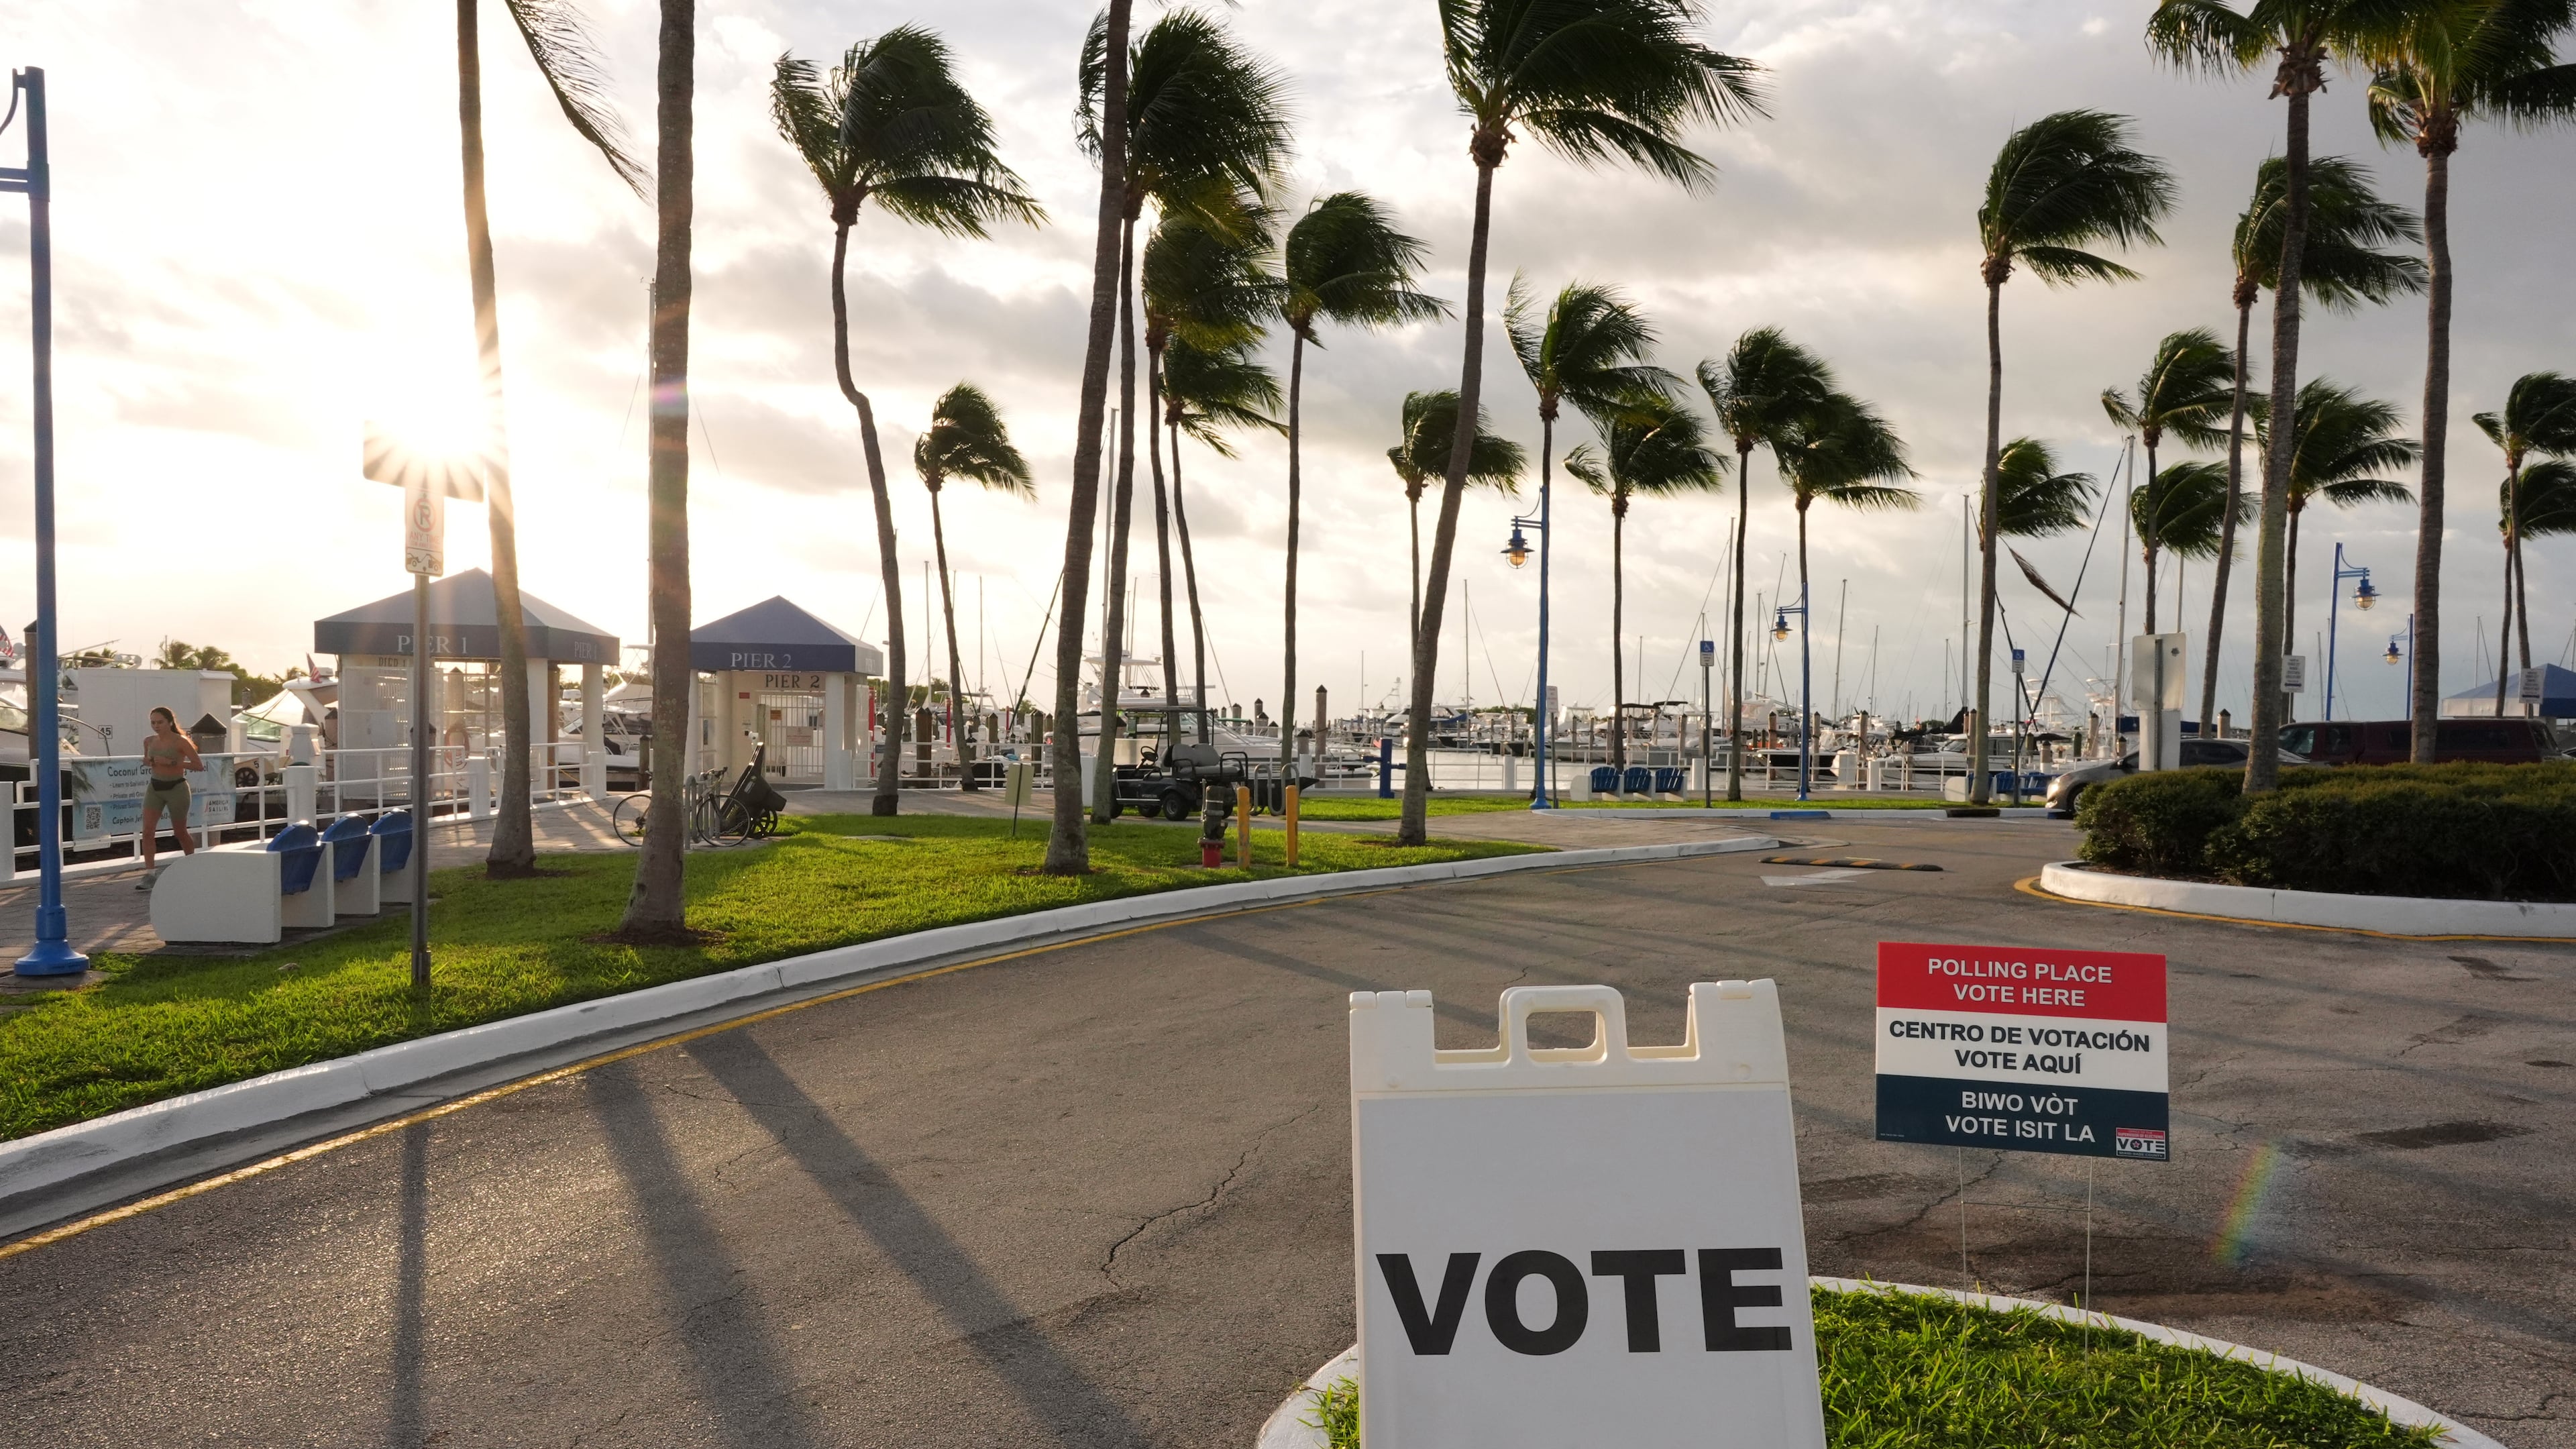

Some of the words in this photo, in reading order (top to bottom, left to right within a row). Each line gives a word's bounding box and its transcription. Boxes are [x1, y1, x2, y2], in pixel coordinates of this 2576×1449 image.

[397, 635, 452, 654] PER
[462, 637, 468, 654] 1
[574, 641, 592, 660] PIER
[731, 653, 776, 668] PIER
[782, 654, 792, 668] 2
[765, 674, 800, 688] PIER
[810, 675, 820, 688] 2
[107, 766, 138, 777] Coconut
[113, 816, 134, 826] Captain
[1928, 958, 2027, 979] POLLING
[2035, 963, 2112, 983] PLACE
[1953, 983, 2015, 1004] VOTE
[2022, 987, 2085, 1007] HERE
[1889, 1020, 1984, 1042] CENTRO
[1990, 1026, 2022, 1045] DE
[2028, 1028, 2150, 1053] VOTACIÓN
[1955, 1049, 2017, 1071] VOTE
[2022, 1053, 2082, 1075] AQUÍ
[1962, 1091, 2023, 1113] BIWO
[2030, 1093, 2078, 1116] VÒT
[1945, 1115, 2008, 1138] VOTE
[2015, 1120, 2057, 1140] ISIT
[2065, 1124, 2096, 1143] LA
[2117, 1138, 2165, 1152] VOTE
[1376, 1247, 1792, 1355] VOTE
